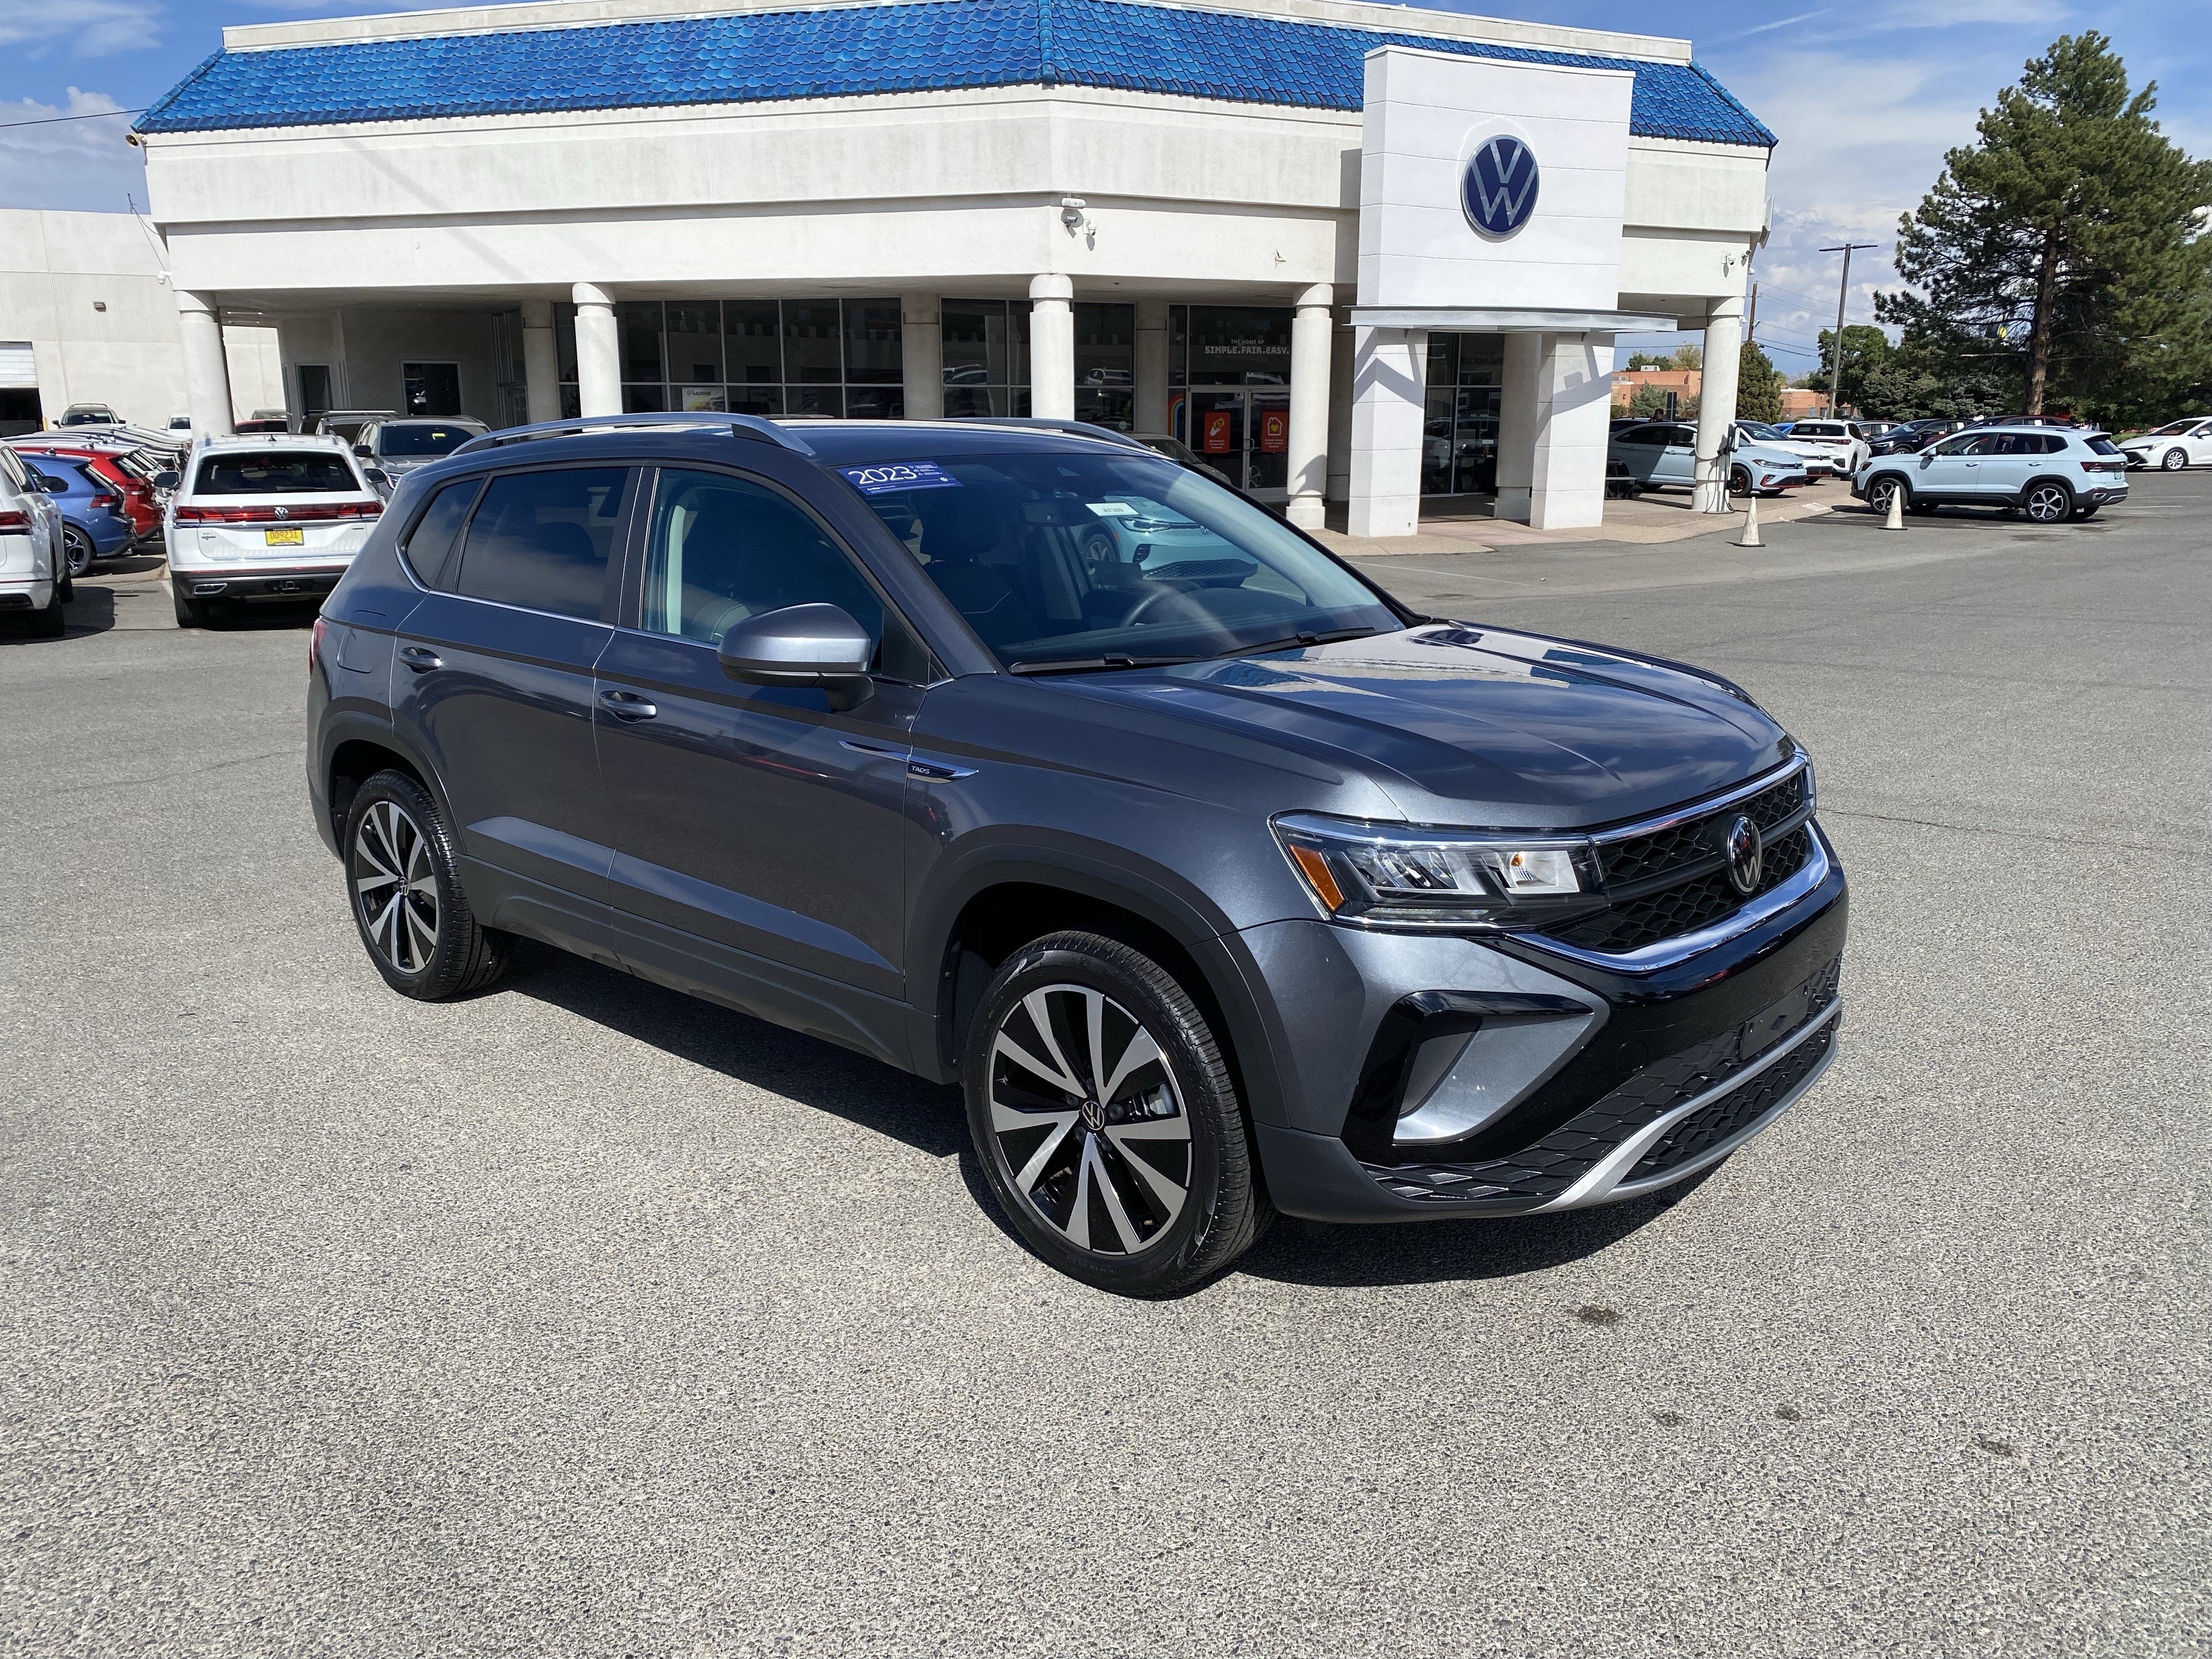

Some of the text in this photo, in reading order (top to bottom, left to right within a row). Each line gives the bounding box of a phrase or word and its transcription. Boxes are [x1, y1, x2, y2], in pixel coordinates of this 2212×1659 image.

[1466, 137, 1539, 228] VW
[848, 466, 917, 484] 2023
[911, 765, 930, 774] TAOS
[1082, 1101, 1104, 1130] VW
